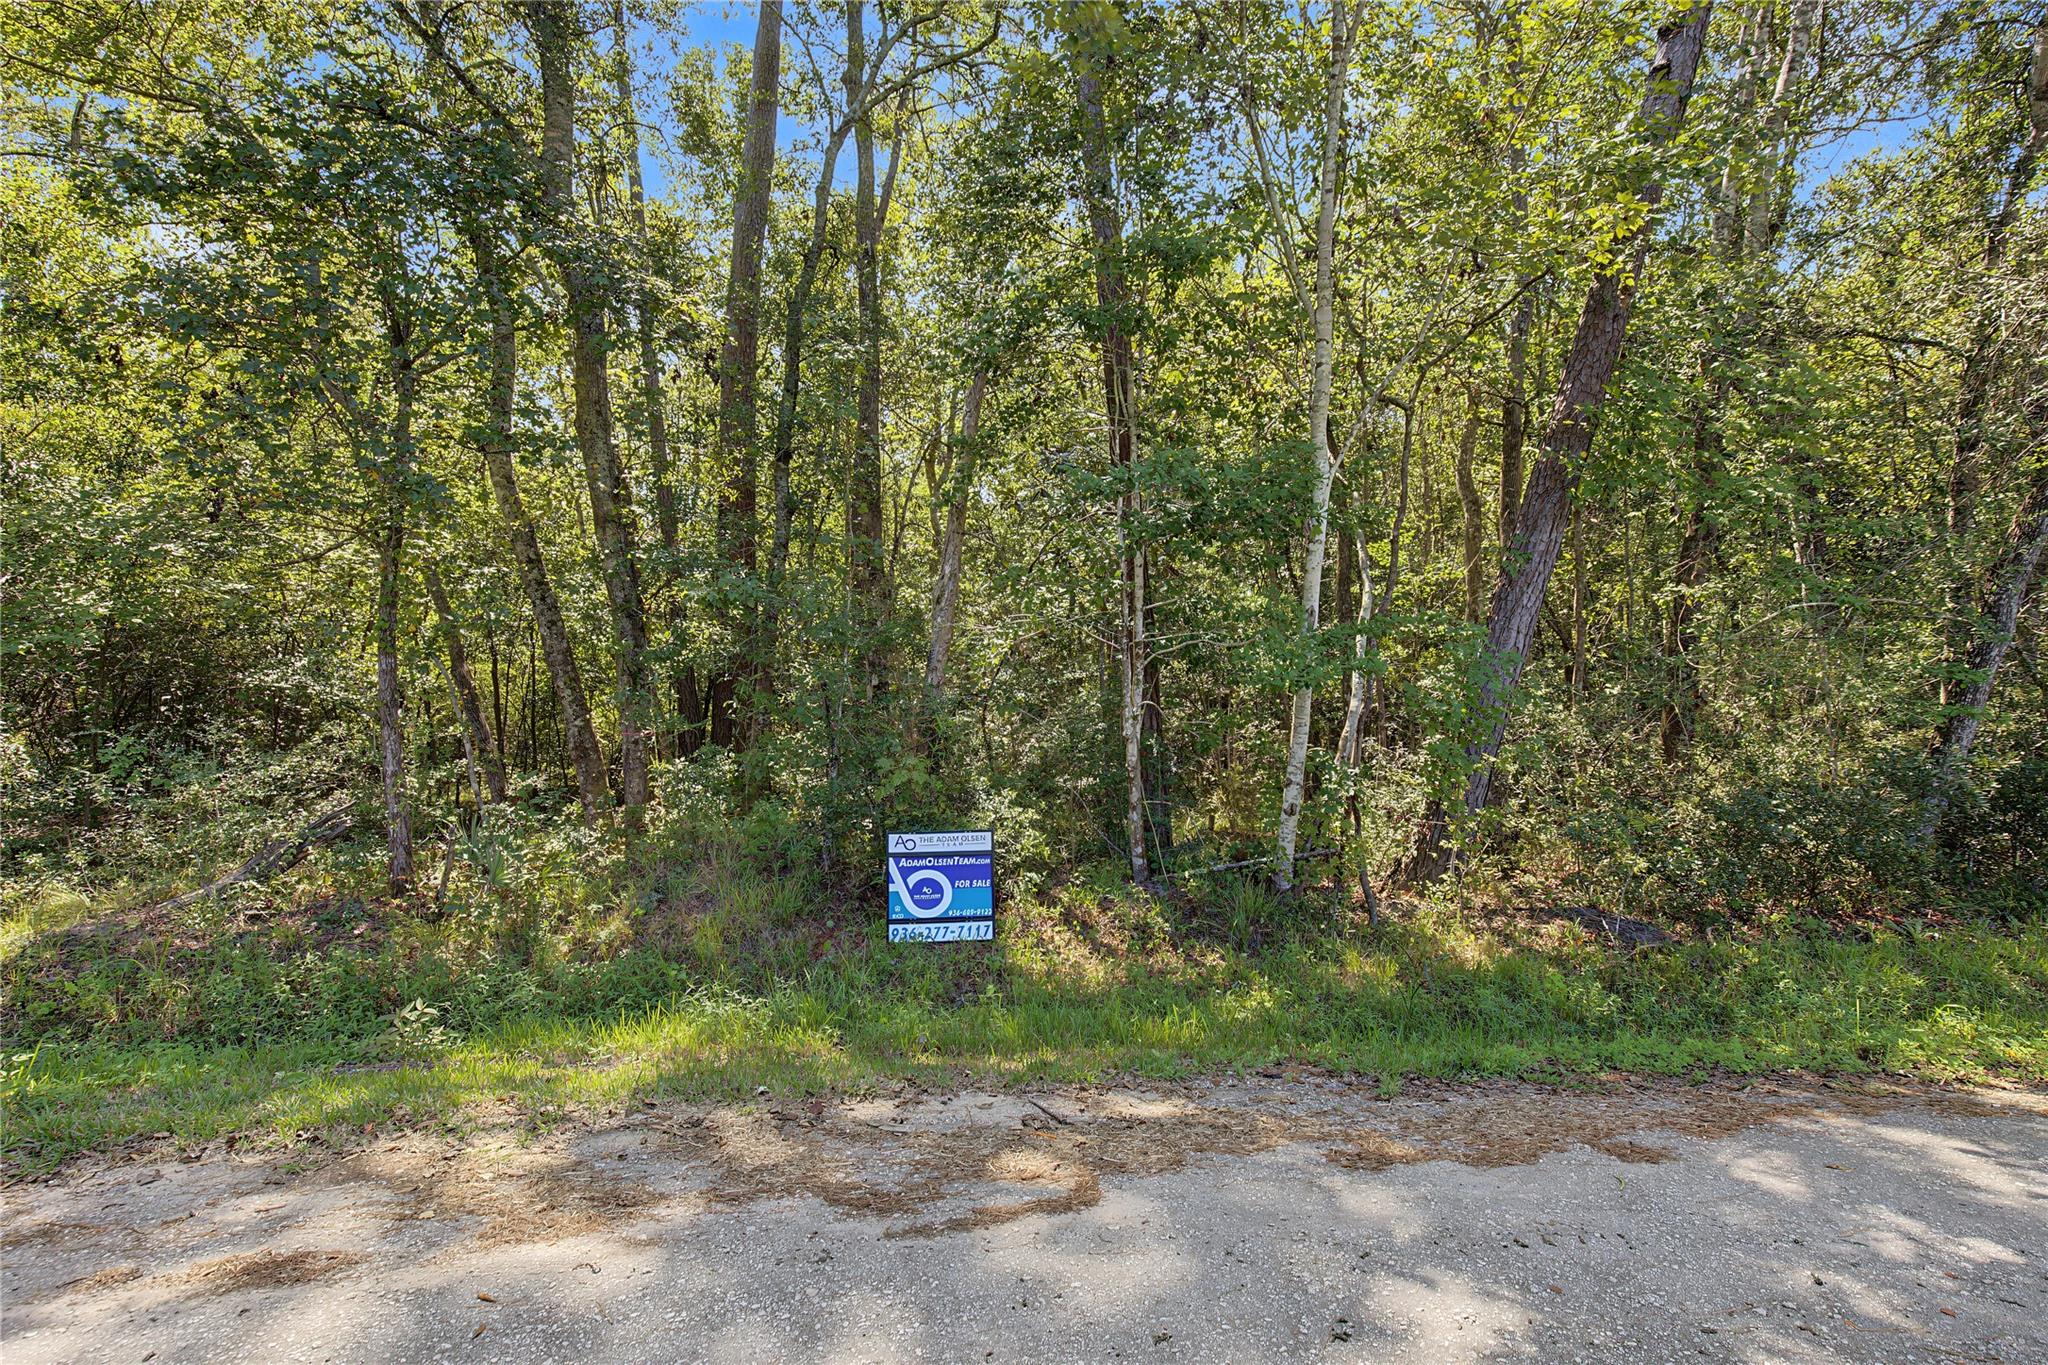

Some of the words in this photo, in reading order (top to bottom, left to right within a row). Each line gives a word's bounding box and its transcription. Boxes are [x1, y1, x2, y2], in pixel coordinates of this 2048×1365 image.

[954, 880, 970, 888] FOR
[972, 879, 991, 888] SALE
[891, 925, 990, 940] 936-277-7117
